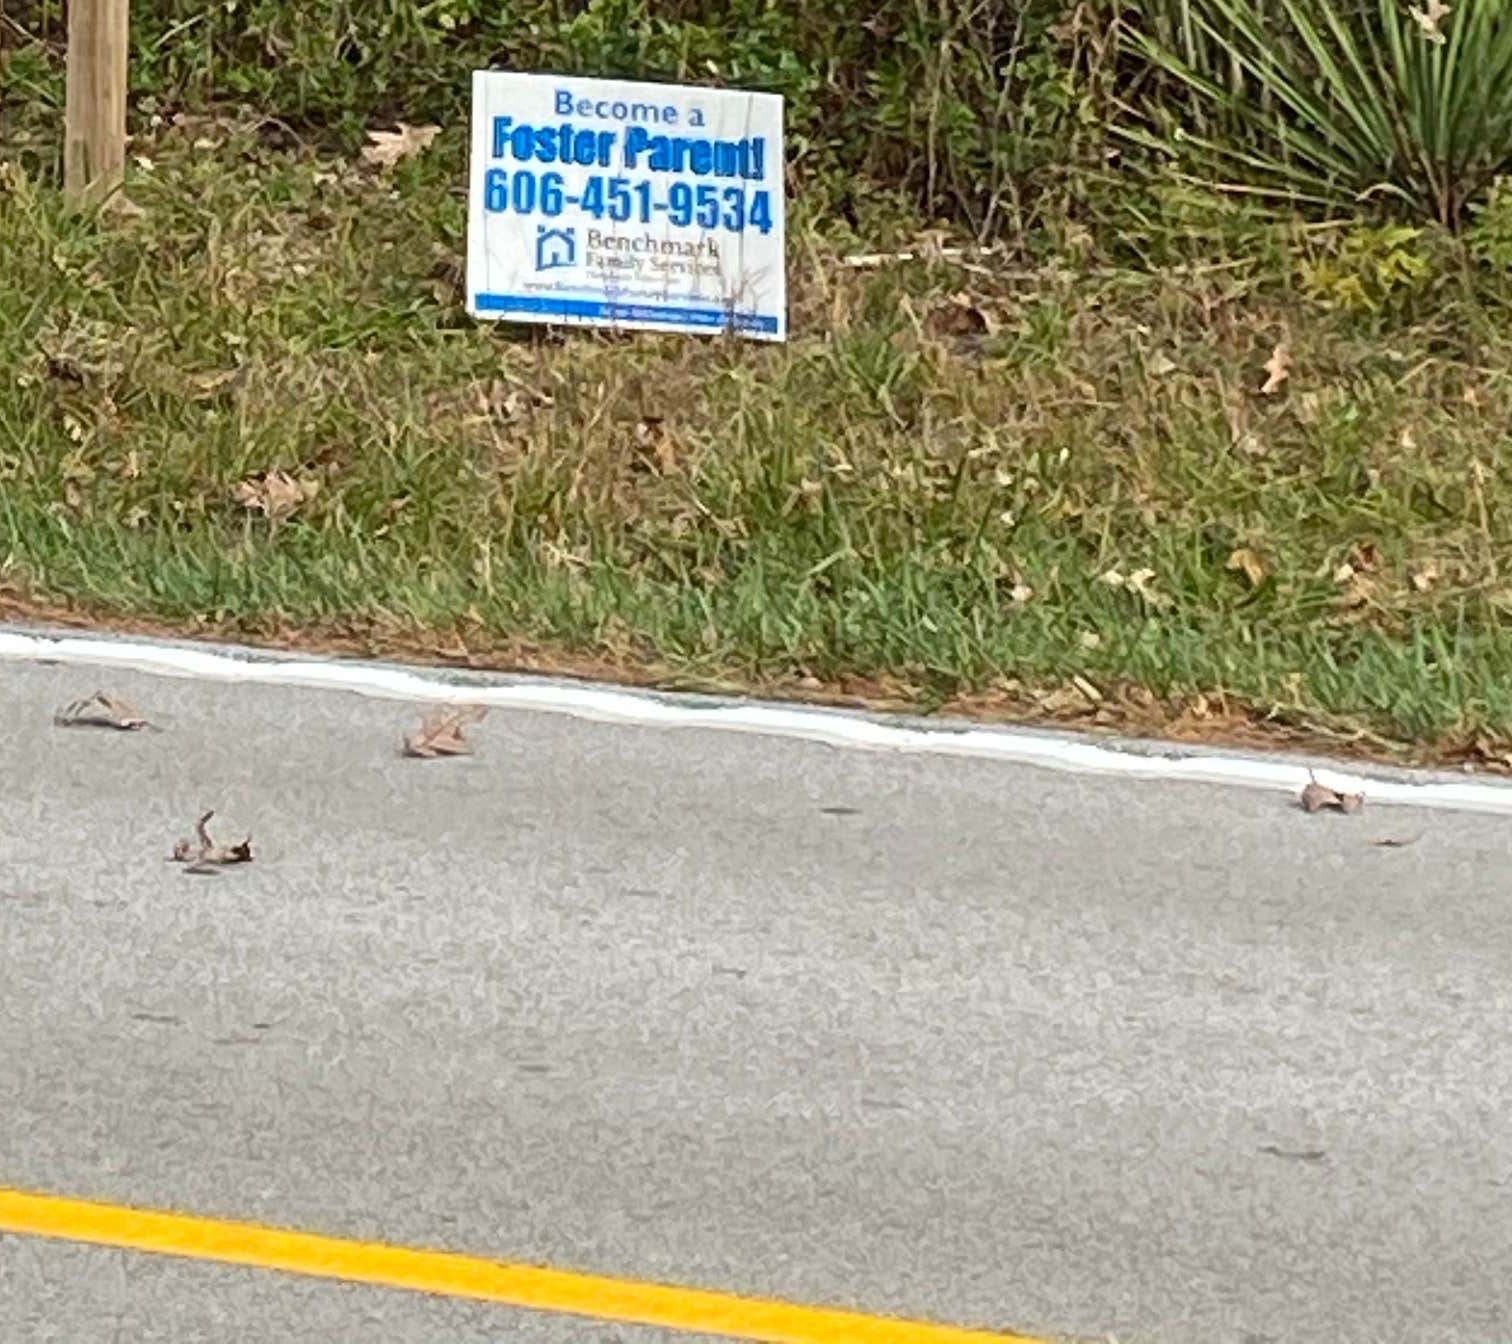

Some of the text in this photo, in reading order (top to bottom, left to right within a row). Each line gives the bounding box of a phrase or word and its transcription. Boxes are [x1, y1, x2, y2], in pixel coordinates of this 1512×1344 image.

[554, 89, 706, 127] Become a
[491, 116, 765, 181] Foster Parent!
[484, 167, 773, 235] 606-451-9534
[587, 229, 720, 259] Benchmark
[587, 251, 646, 272] Family
